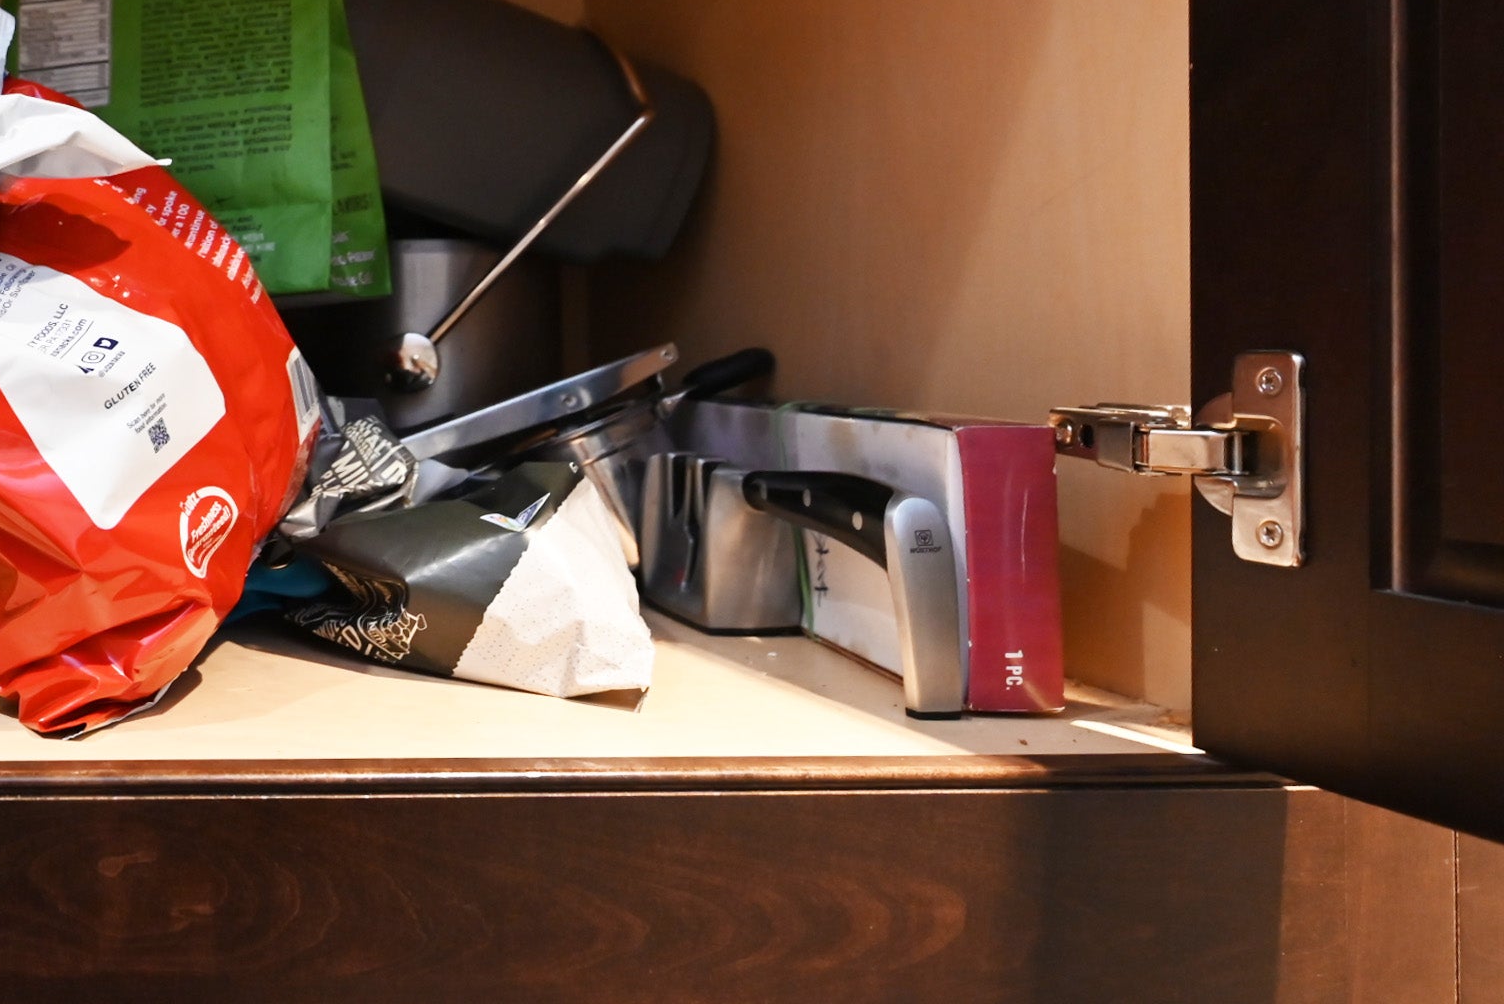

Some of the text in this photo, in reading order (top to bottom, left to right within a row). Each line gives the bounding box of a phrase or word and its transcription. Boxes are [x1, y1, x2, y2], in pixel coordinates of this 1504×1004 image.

[104, 362, 157, 410] GLUTEN FREE
[191, 501, 222, 544] Freshness
[1004, 650, 1024, 692] 1 PC.
